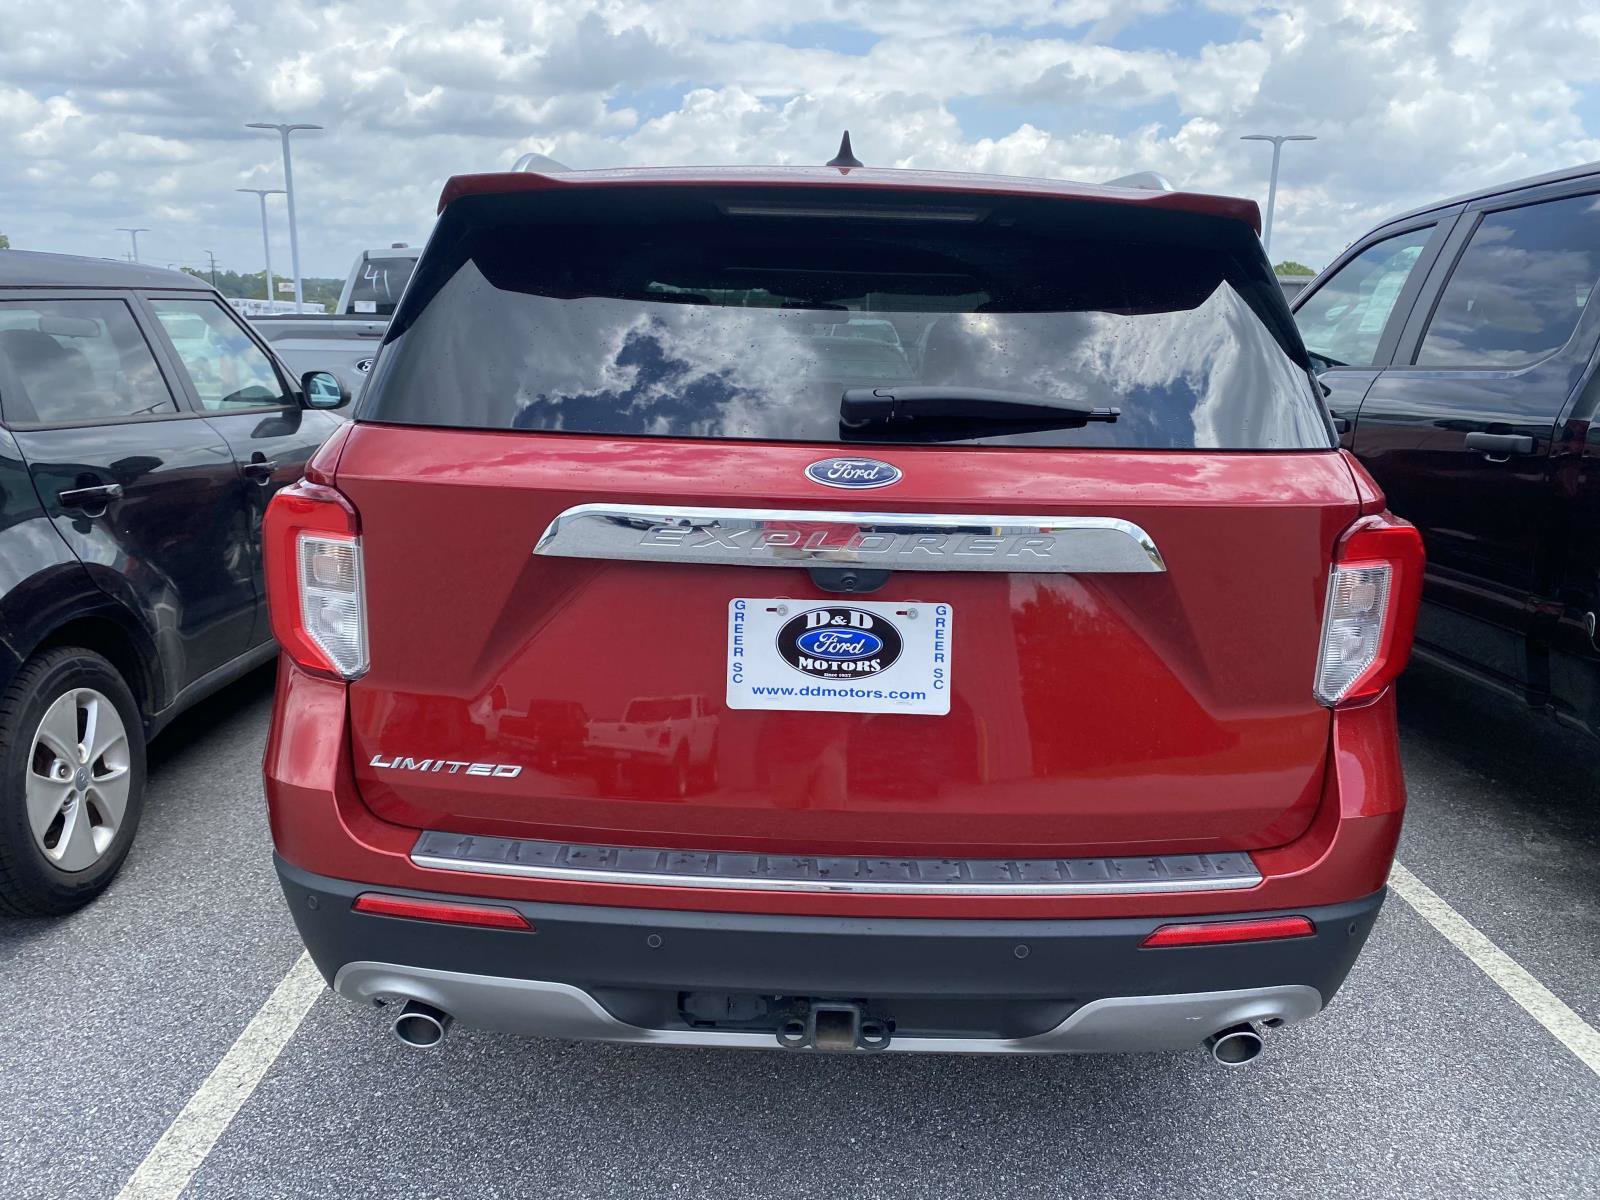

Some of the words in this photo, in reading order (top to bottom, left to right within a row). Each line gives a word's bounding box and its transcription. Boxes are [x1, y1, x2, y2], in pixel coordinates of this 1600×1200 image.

[363, 264, 391, 298] 41
[827, 461, 880, 480] Ford
[640, 526, 1058, 558] EXPLORER
[734, 600, 746, 657] GREER
[805, 610, 874, 629] D&D
[813, 632, 865, 655] Ford
[934, 605, 947, 662] GREER
[732, 662, 744, 684] SC
[798, 656, 881, 673] MOTORS
[933, 668, 944, 690] SC
[751, 685, 927, 700] www.ddmotors.com
[369, 754, 523, 778] LIMITED
